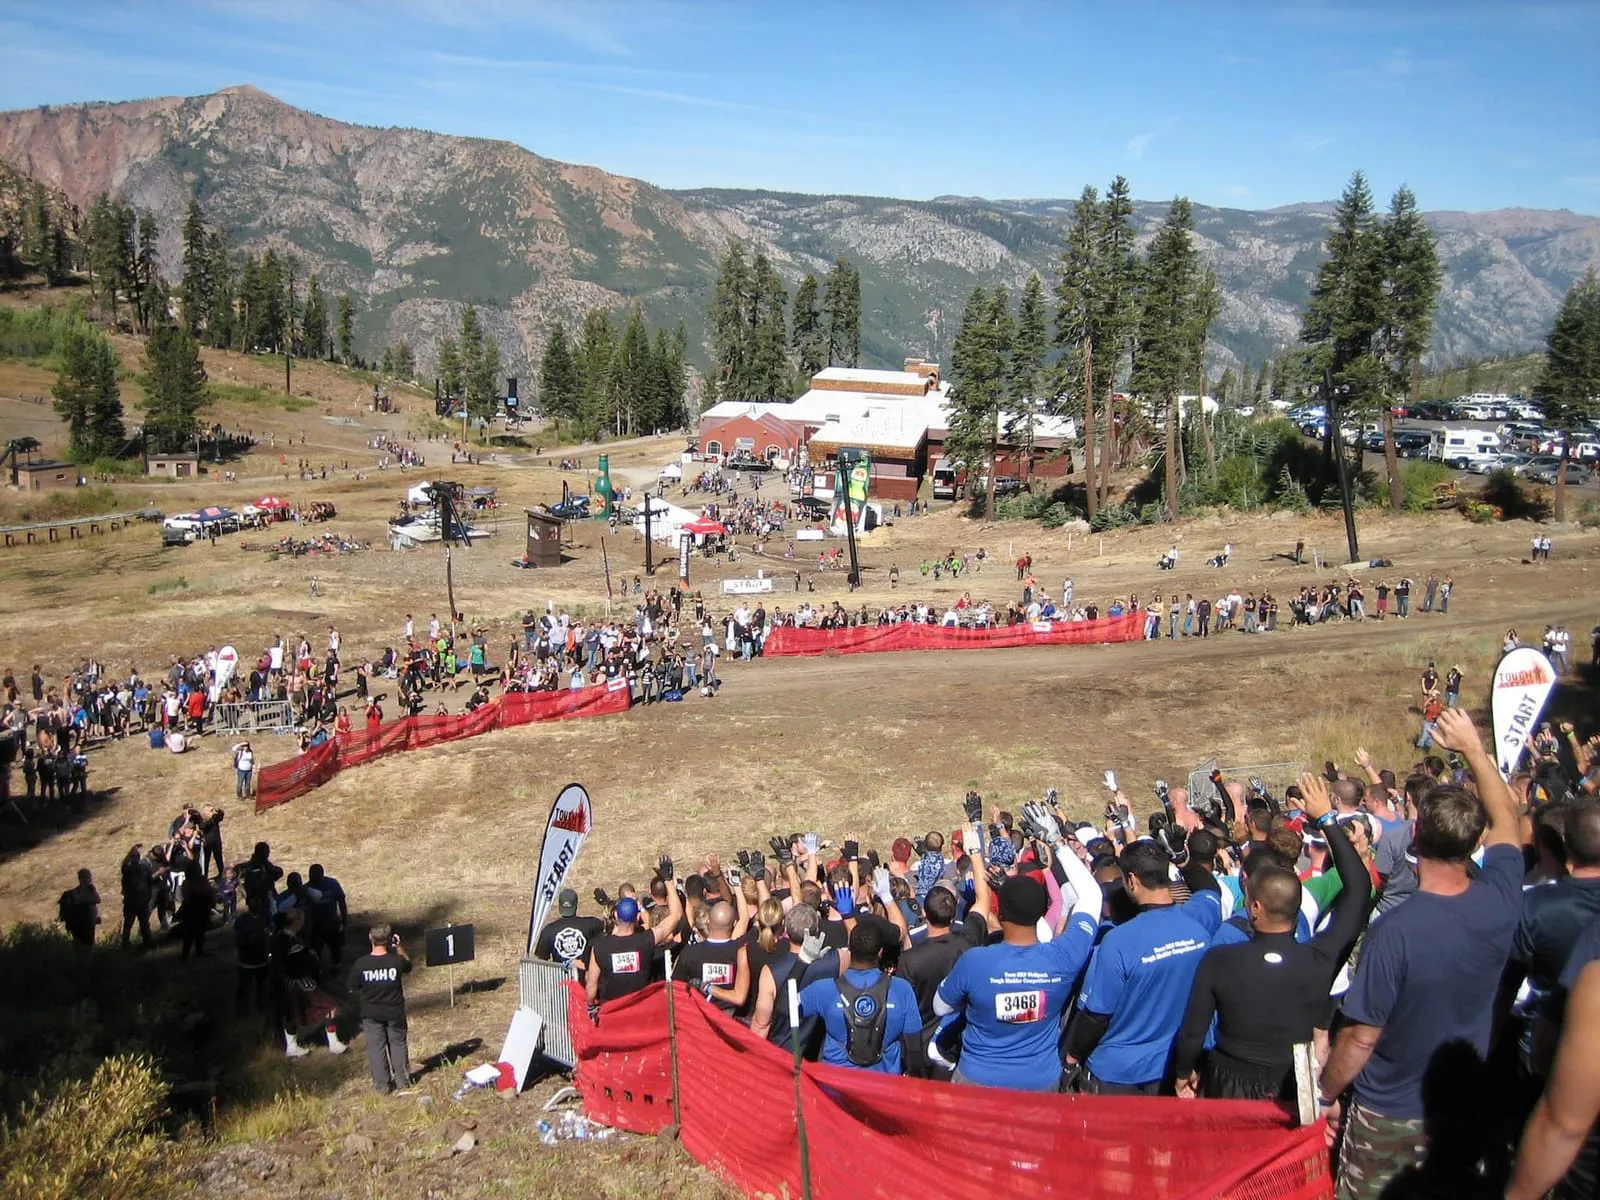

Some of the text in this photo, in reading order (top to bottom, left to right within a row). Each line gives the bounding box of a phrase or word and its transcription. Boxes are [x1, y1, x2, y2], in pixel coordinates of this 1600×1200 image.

[1503, 693, 1537, 747] START
[542, 838, 574, 902] START
[445, 934, 455, 957] 1
[616, 954, 636, 964] 3484
[363, 967, 398, 982] TMHQ
[707, 964, 728, 975] 3481
[1004, 994, 1037, 1011] 3468
